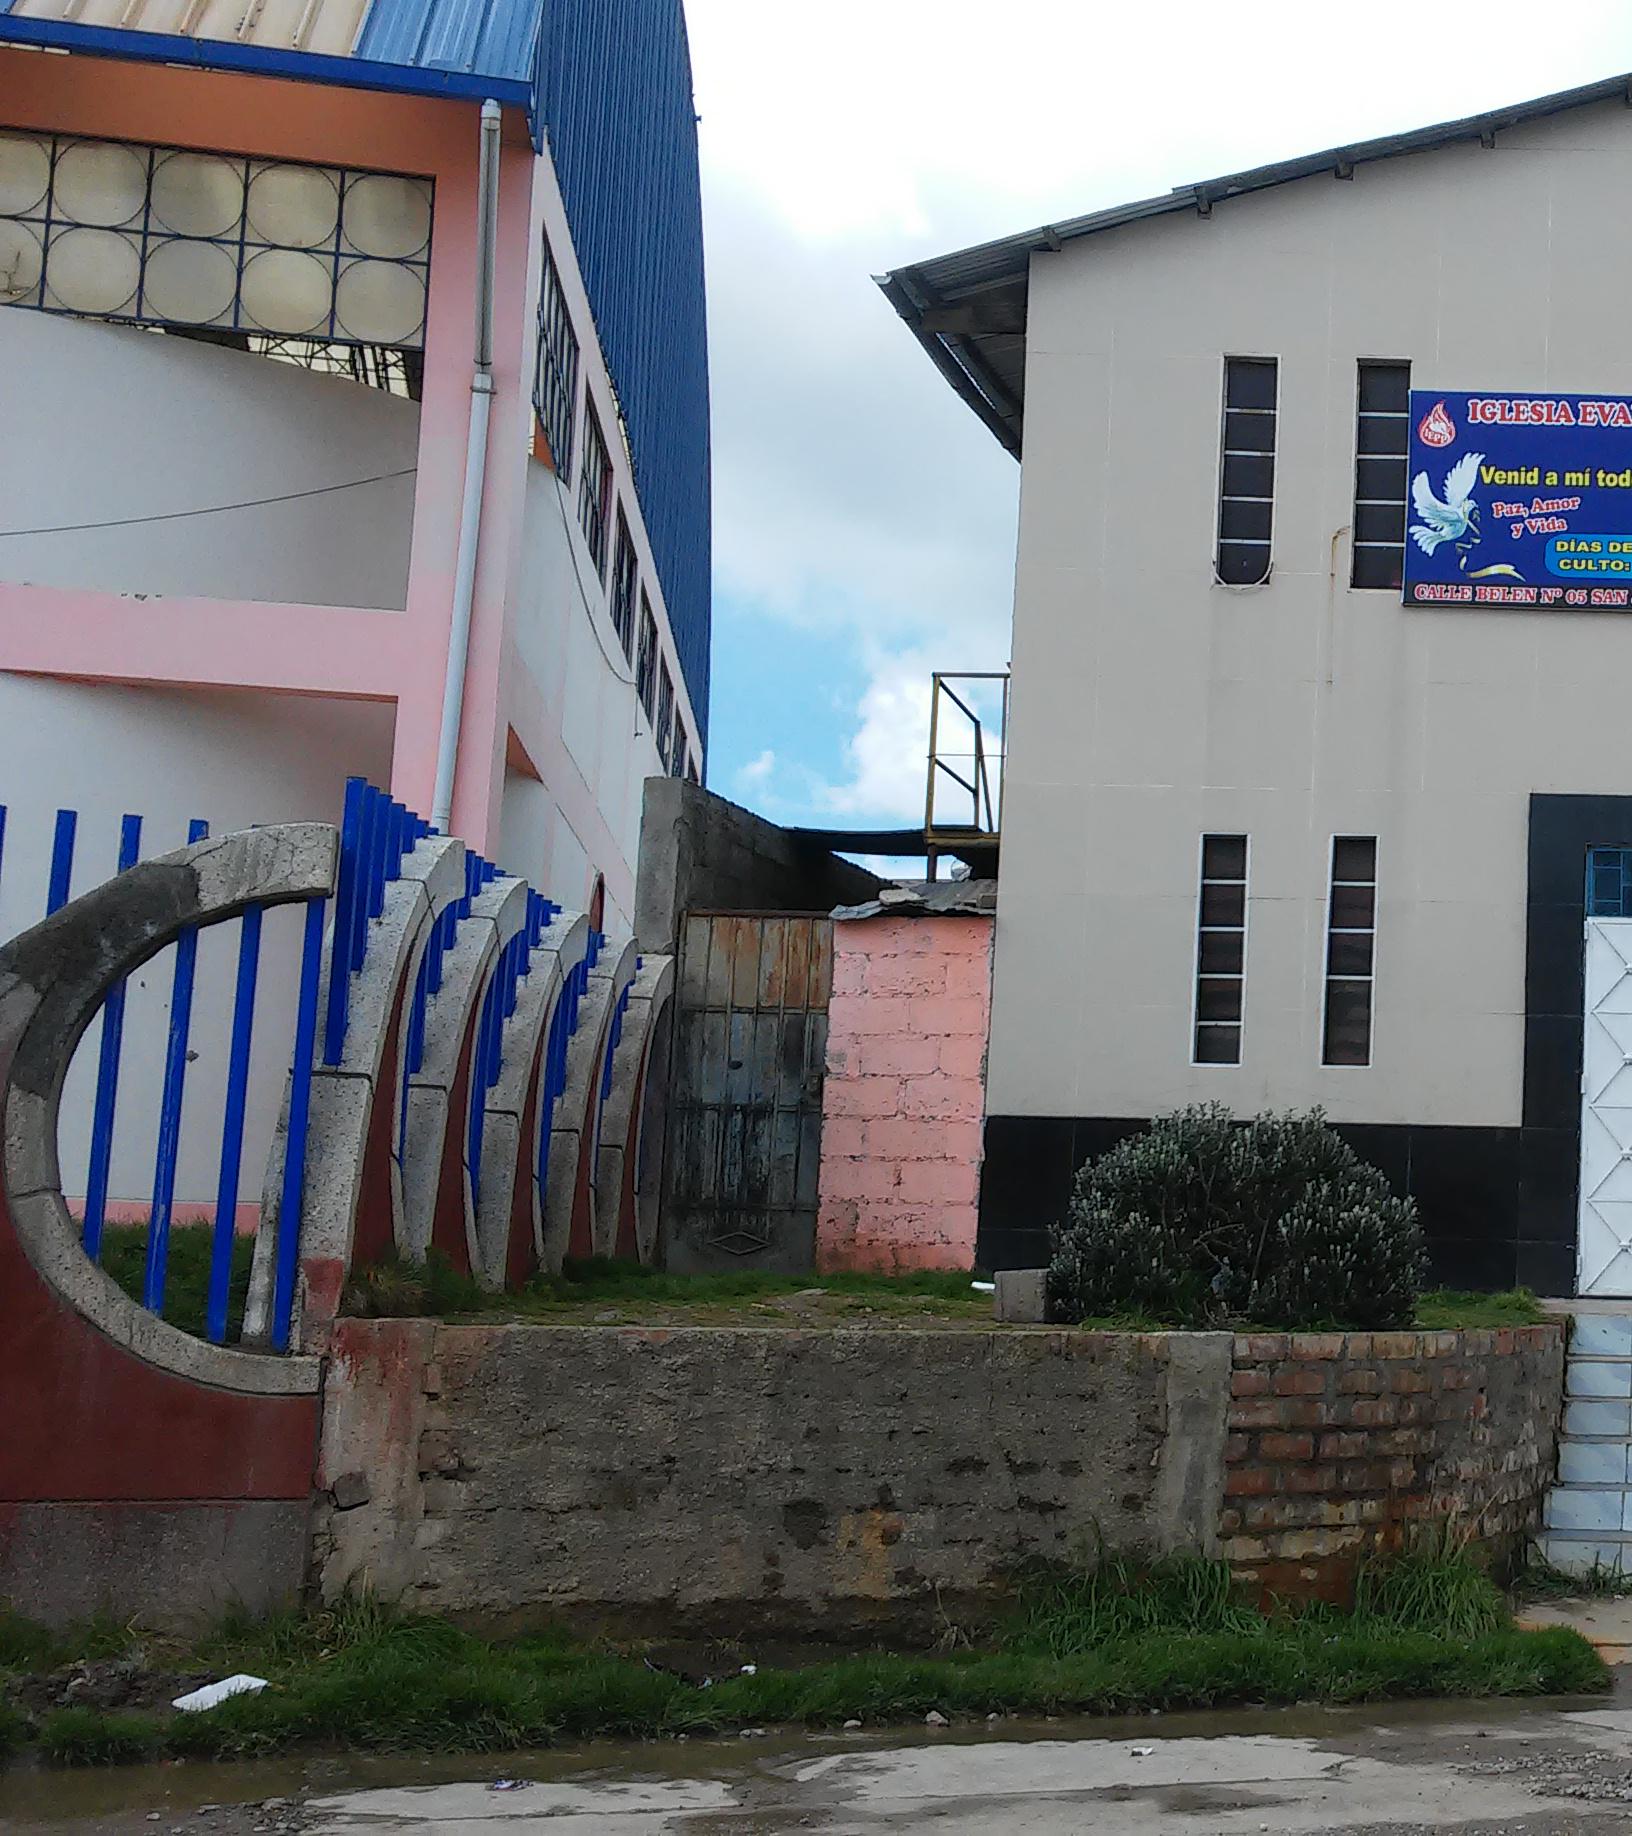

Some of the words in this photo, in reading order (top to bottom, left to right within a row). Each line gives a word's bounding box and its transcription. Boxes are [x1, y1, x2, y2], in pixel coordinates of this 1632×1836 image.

[1468, 399, 1576, 425] IGLESIA
[1480, 466, 1539, 486] Venid
[1546, 471, 1558, 486] a
[1565, 468, 1590, 486] mí
[1492, 501, 1529, 518] Paz,
[1531, 497, 1580, 514] Amor
[1511, 523, 1524, 538] y
[1526, 517, 1568, 534] Vida
[1556, 538, 1602, 553] DÍAS
[1559, 558, 1631, 571] CULTO:
[1415, 584, 1473, 601] CALLE
[1475, 585, 1538, 602] BELEN
[1567, 588, 1587, 604] 05
[1591, 589, 1628, 605] SAN
